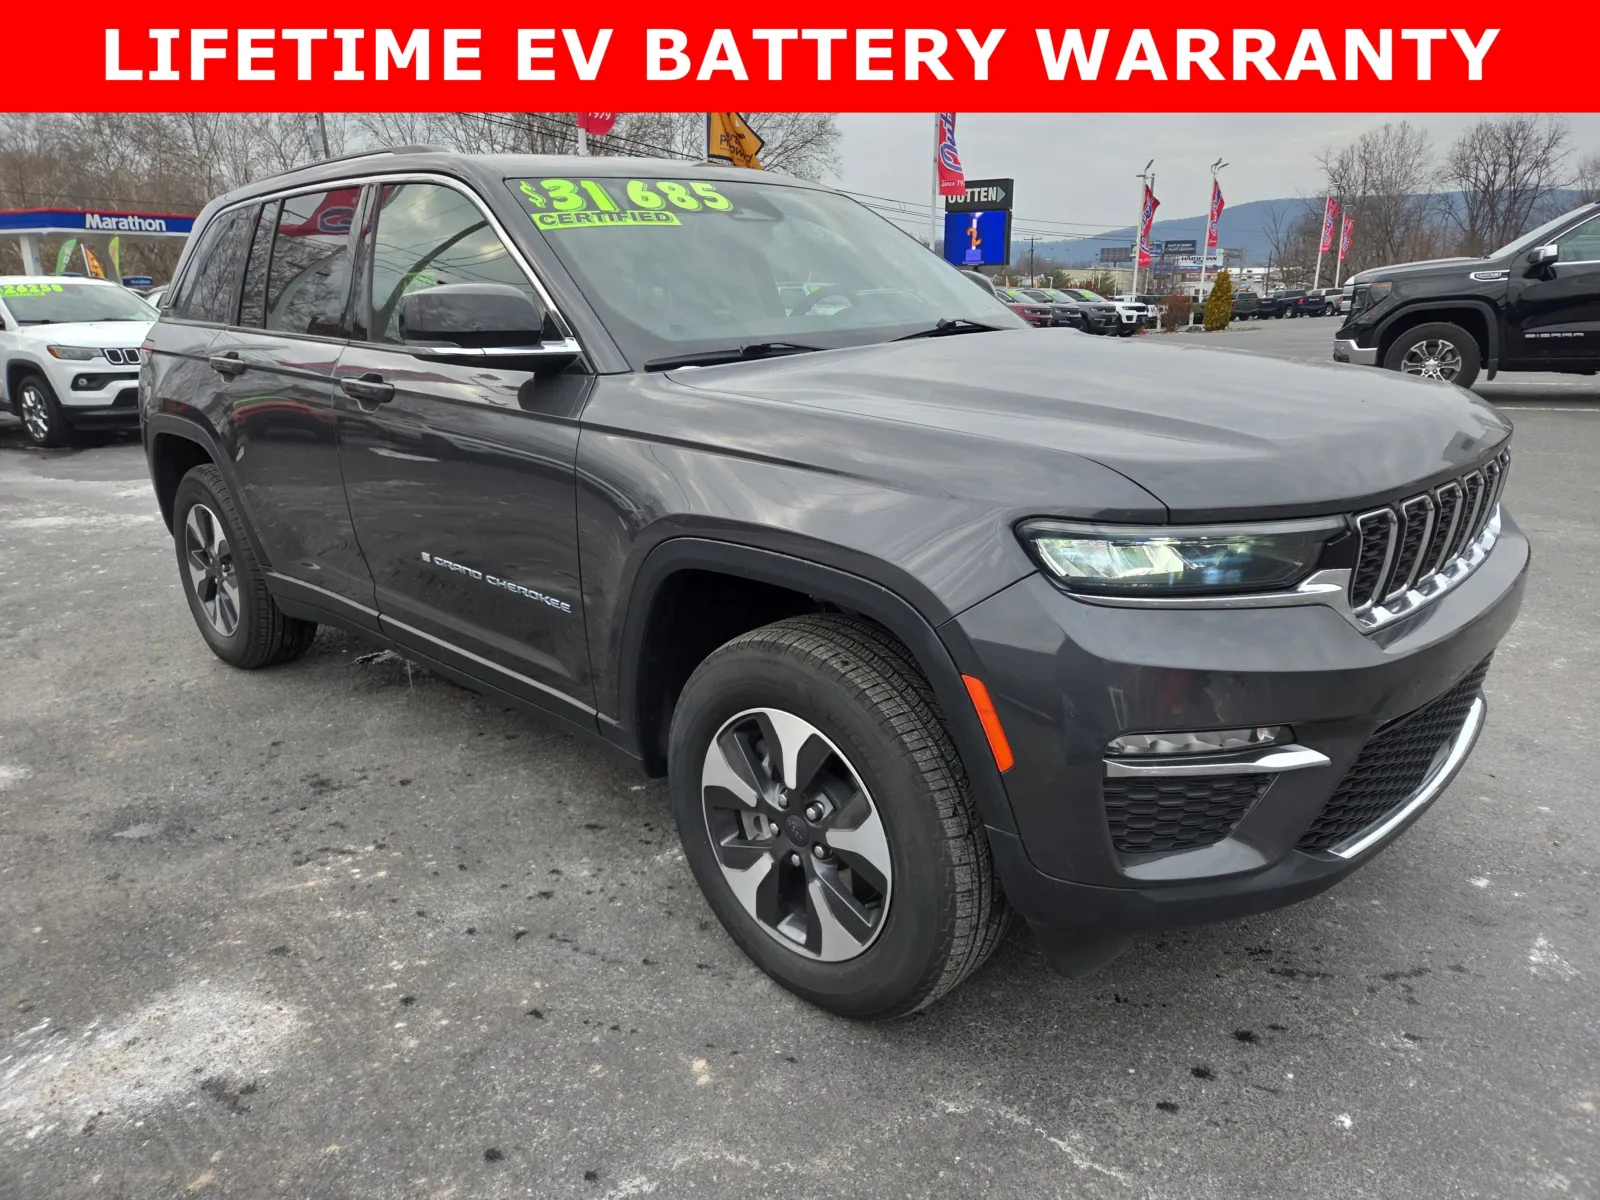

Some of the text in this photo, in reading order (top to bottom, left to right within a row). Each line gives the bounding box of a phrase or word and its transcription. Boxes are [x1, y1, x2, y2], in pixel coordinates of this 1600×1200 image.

[85, 213, 167, 232] Marathon
[538, 211, 675, 226] CERTIFIED
[433, 556, 572, 614] GRAND CHEROKEE
